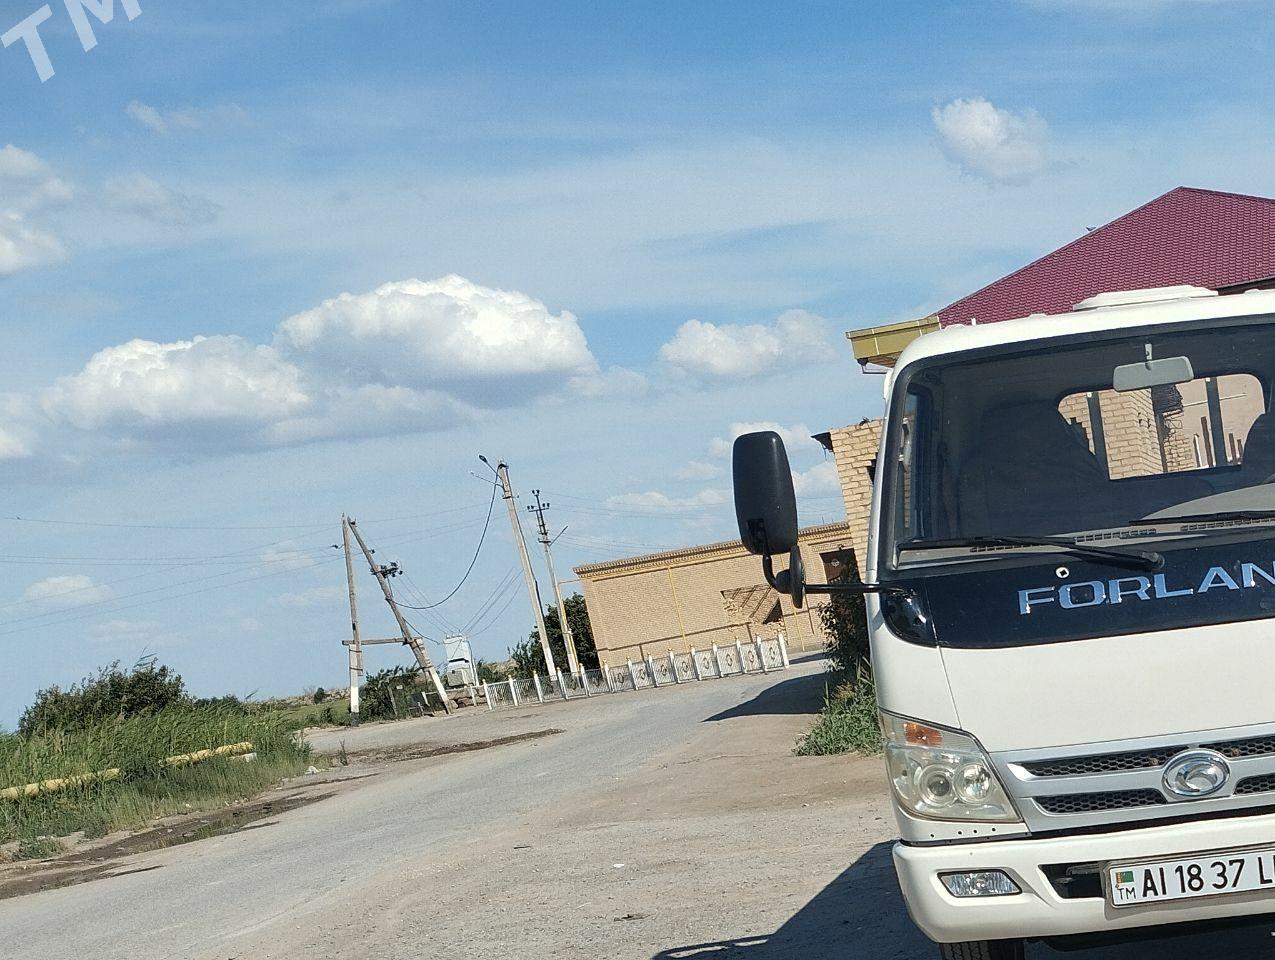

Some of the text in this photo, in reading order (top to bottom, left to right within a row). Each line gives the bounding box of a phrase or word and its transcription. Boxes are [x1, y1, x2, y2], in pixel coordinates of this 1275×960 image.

[1174, 863, 1205, 894] 18
[1210, 859, 1246, 890] 37
[1117, 886, 1137, 901] TM
